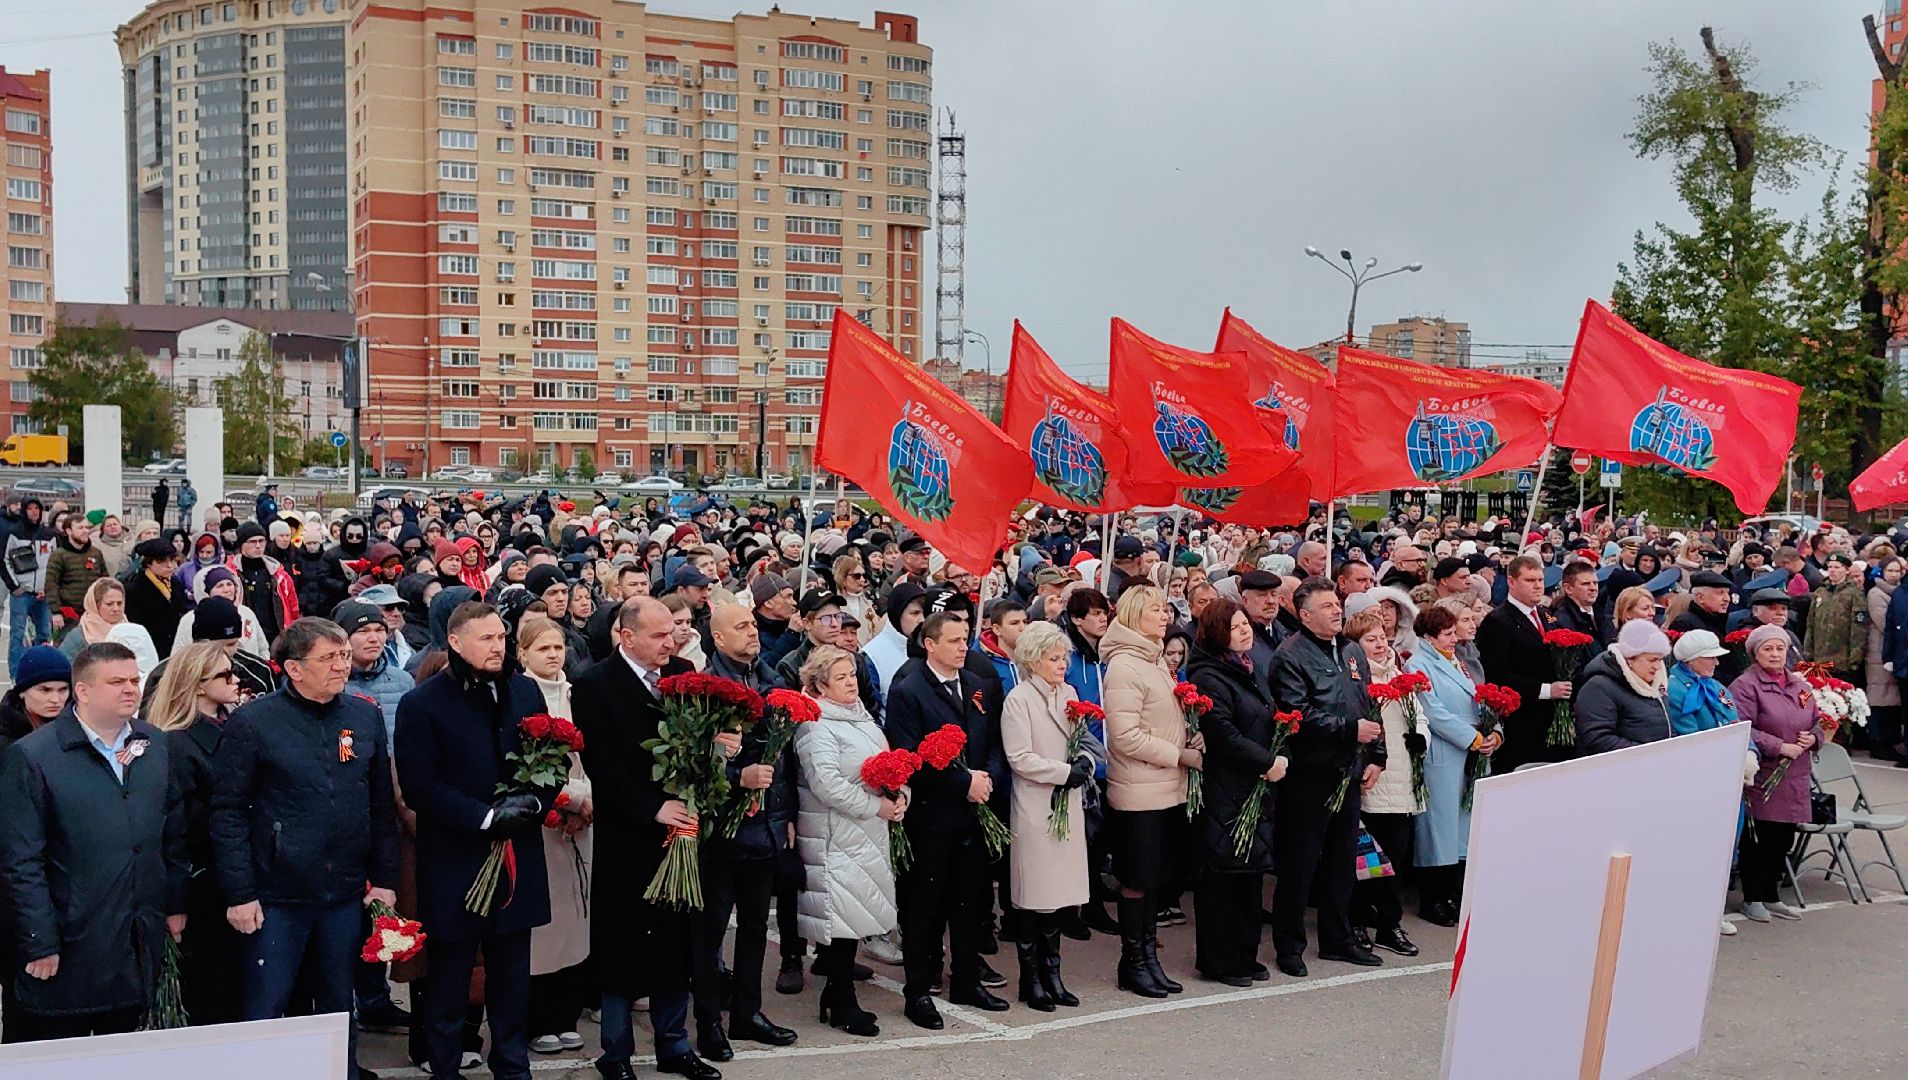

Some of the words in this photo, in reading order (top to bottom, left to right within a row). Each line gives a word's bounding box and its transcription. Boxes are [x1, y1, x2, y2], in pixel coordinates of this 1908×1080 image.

[1050, 395, 1100, 423] Боевое
[1668, 386, 1725, 413] Боевое
[911, 401, 964, 447] Боевое
